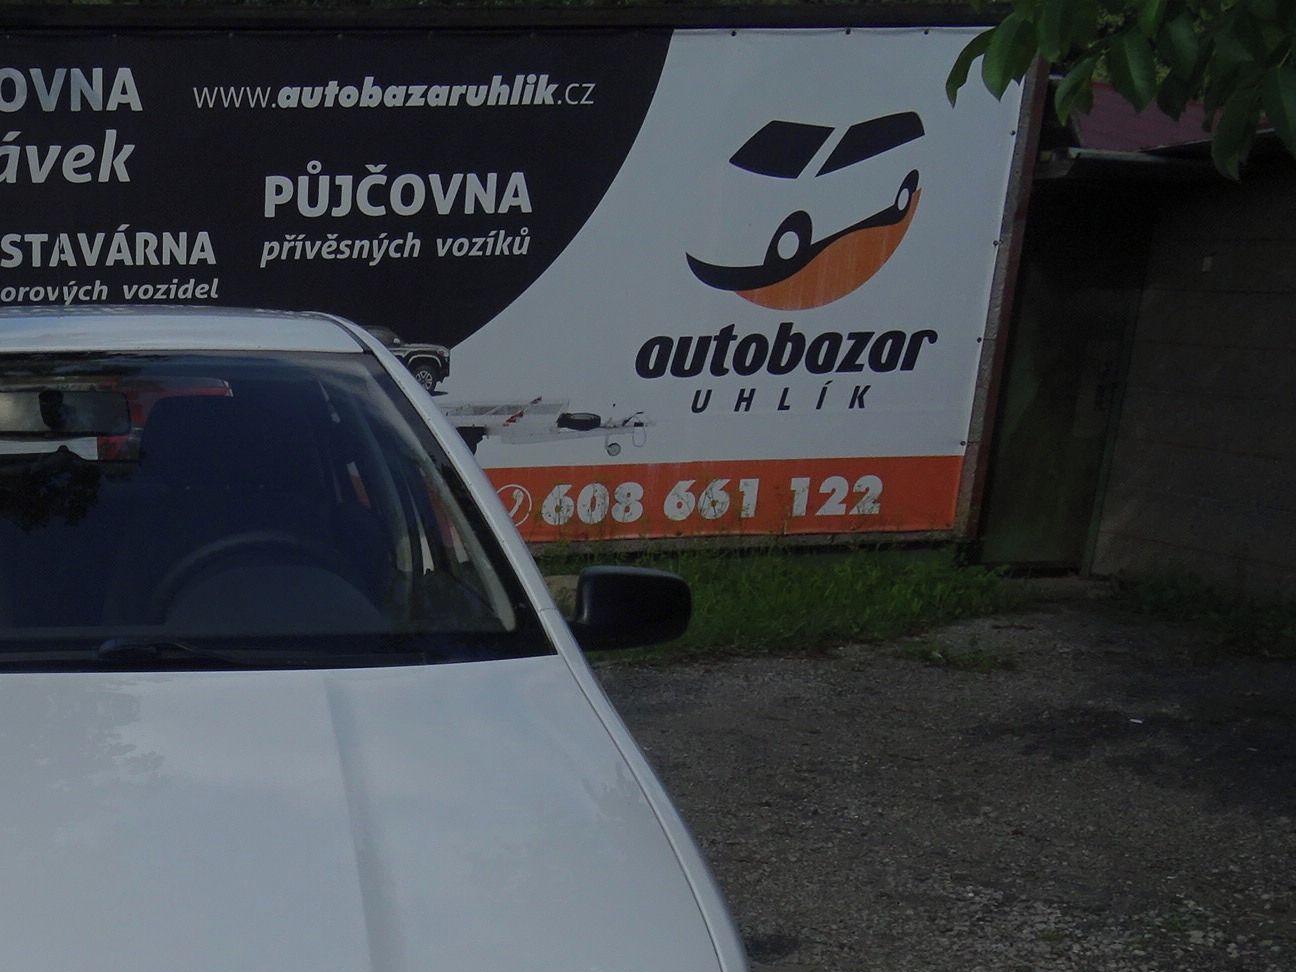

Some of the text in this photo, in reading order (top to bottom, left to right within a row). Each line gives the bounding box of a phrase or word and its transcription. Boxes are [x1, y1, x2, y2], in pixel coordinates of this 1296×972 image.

[193, 74, 596, 109] www.autobazaruhlik.cz
[264, 160, 533, 218] PŮJČOVNA
[260, 227, 531, 268] přívěsných vozíků
[122, 278, 219, 300] vozidel
[635, 322, 937, 379] autobazar
[690, 381, 872, 414] UHLÍK
[541, 474, 882, 526] 608 661 122
